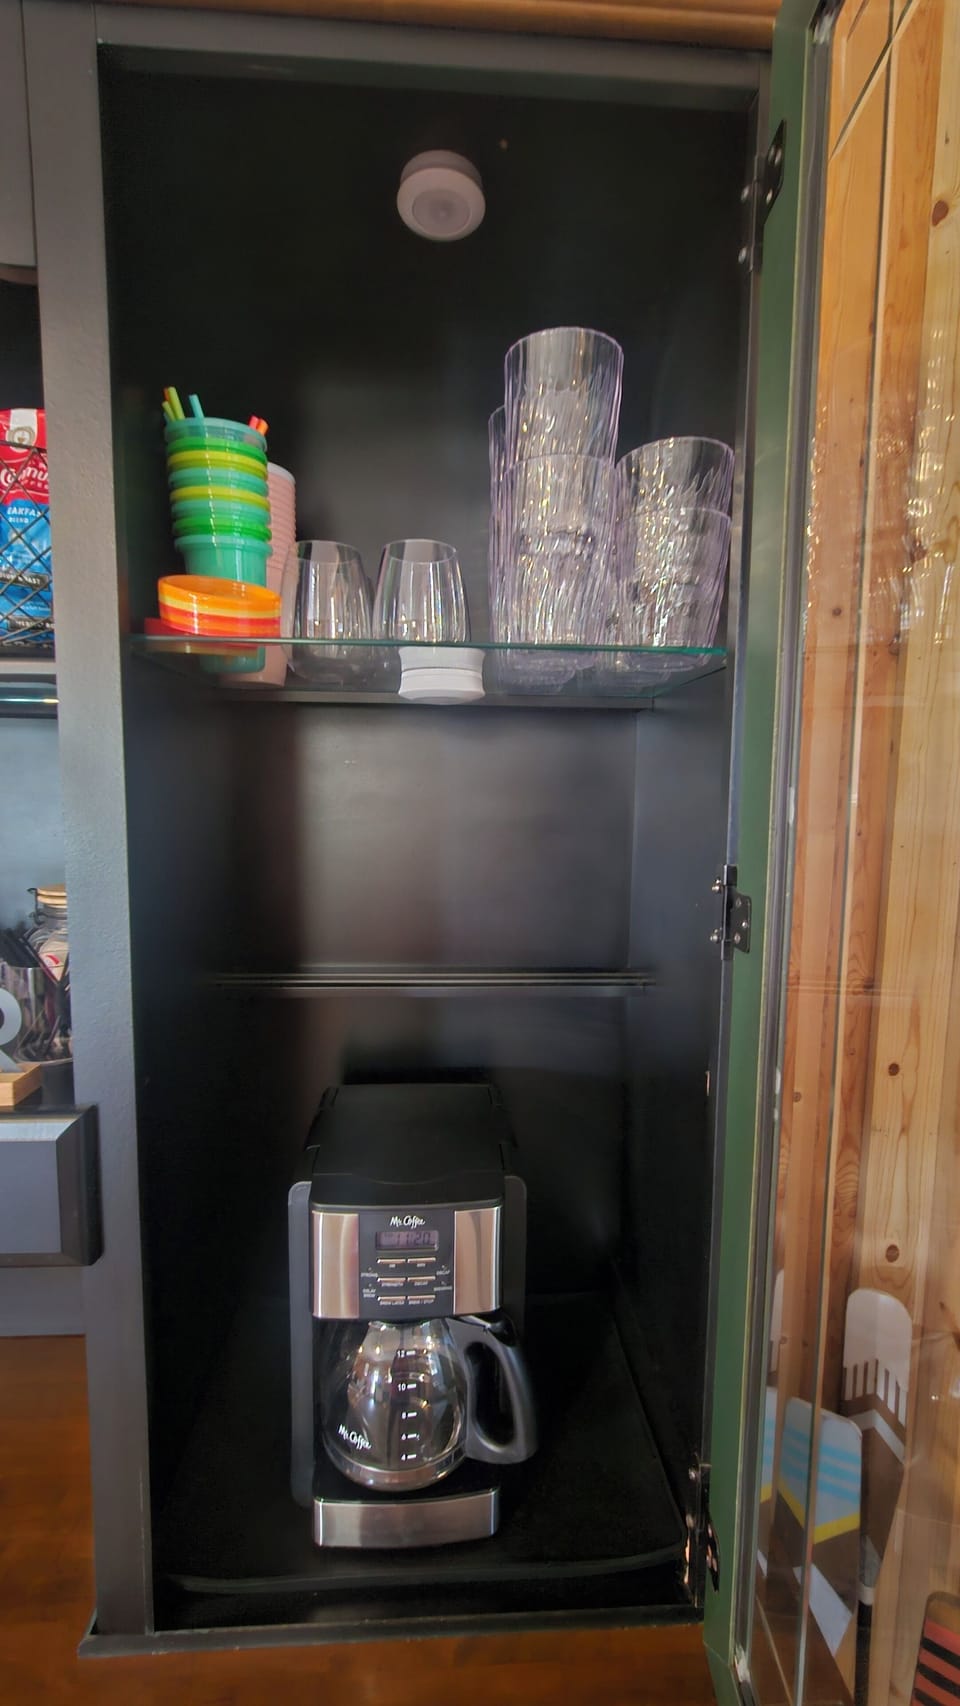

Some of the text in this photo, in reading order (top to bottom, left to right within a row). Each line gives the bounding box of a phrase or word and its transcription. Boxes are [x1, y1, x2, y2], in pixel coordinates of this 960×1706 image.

[403, 1215, 426, 1229] Coffee
[397, 1350, 406, 1358] 12
[398, 1384, 407, 1392] 10
[349, 1431, 372, 1450] Coffee
